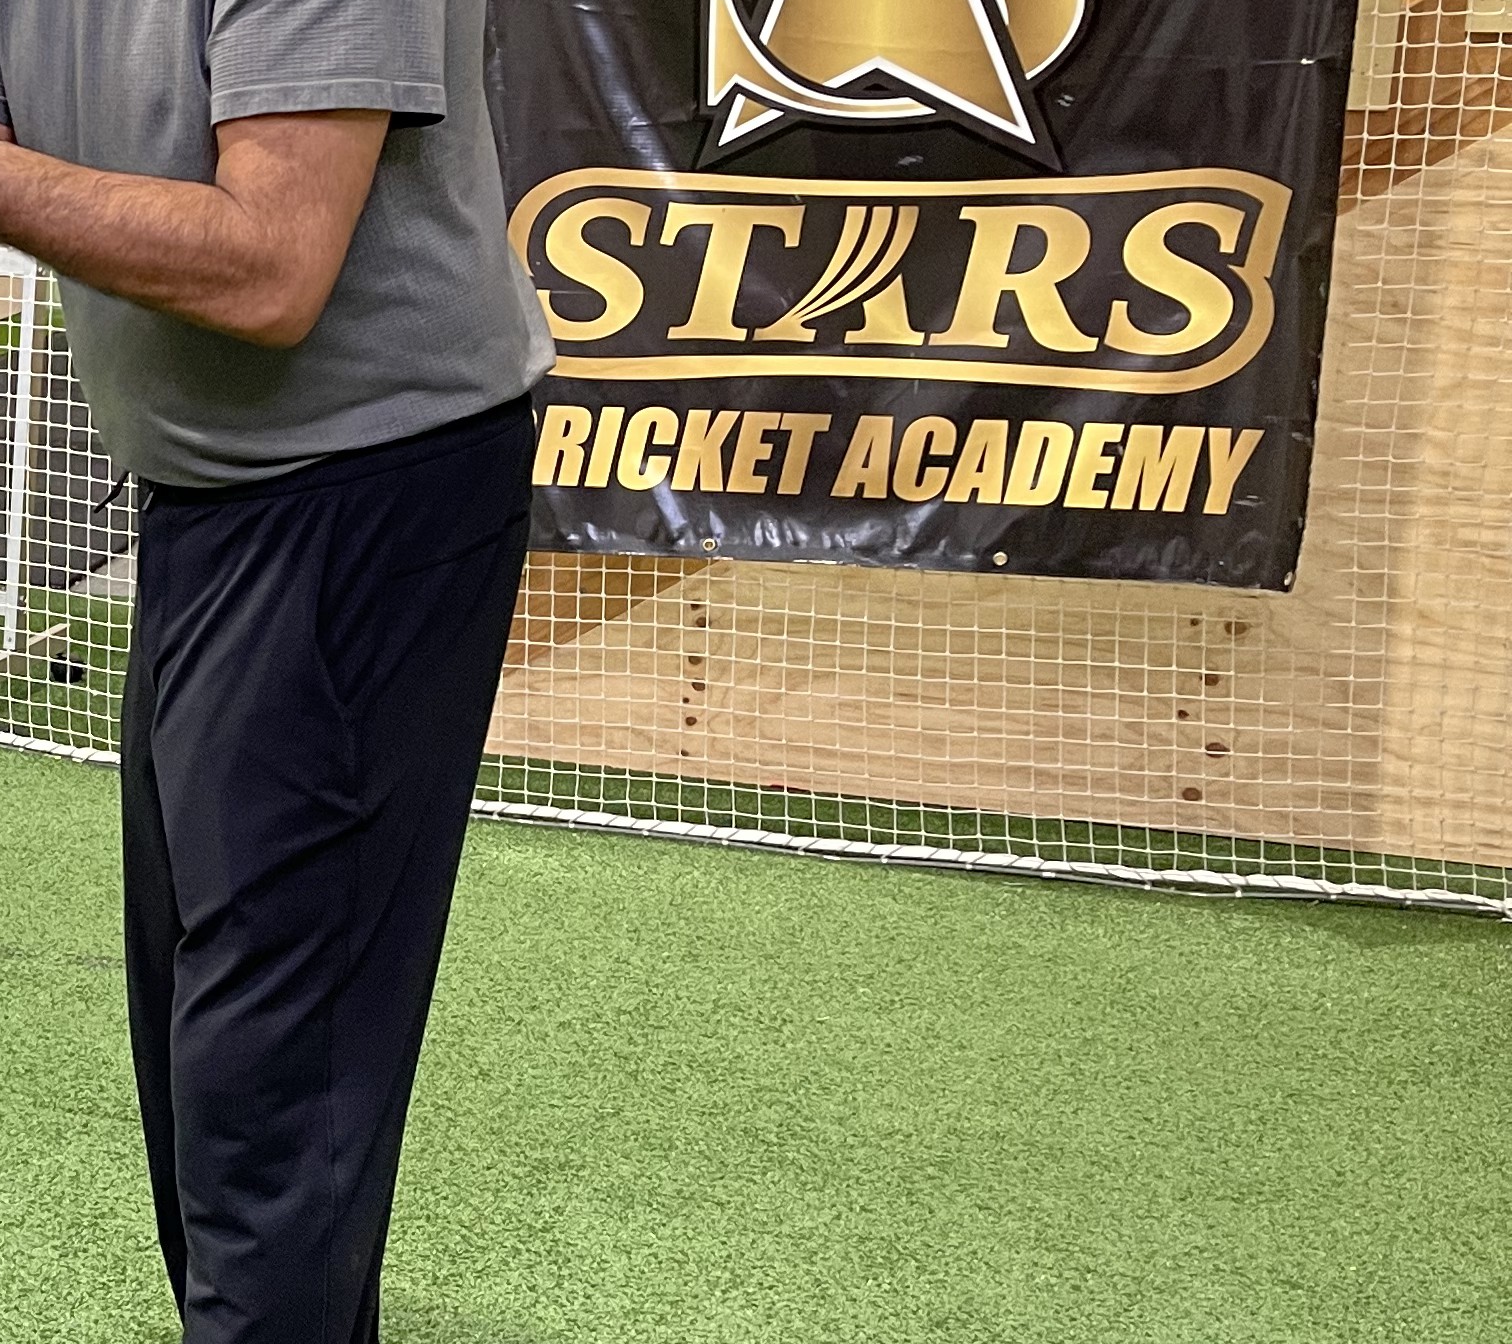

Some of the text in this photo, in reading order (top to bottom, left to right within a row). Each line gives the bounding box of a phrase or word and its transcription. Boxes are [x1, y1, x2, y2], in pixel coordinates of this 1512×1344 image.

[535, 197, 1246, 356] STARS
[531, 405, 1265, 515] RICKET ACADEMY
